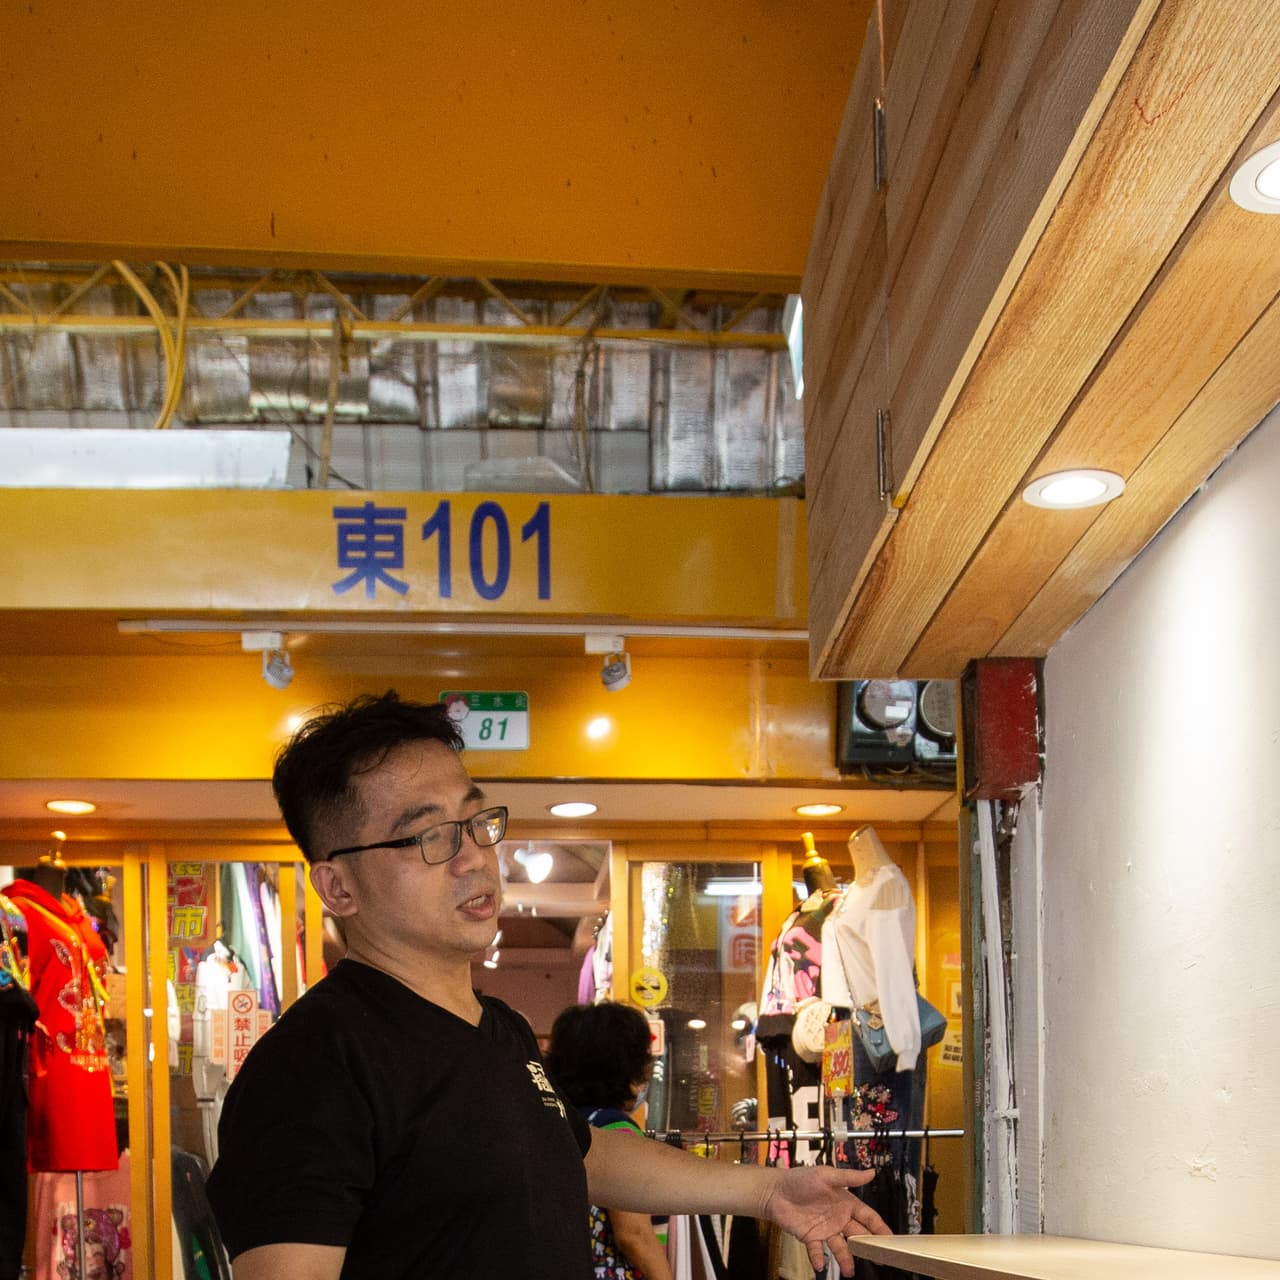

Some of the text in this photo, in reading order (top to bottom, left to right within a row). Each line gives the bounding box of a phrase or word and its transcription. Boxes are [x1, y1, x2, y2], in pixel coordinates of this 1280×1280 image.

[332, 499, 551, 600] 東101
[479, 717, 508, 741] 81
[234, 1018, 252, 1075] 禁止吸
